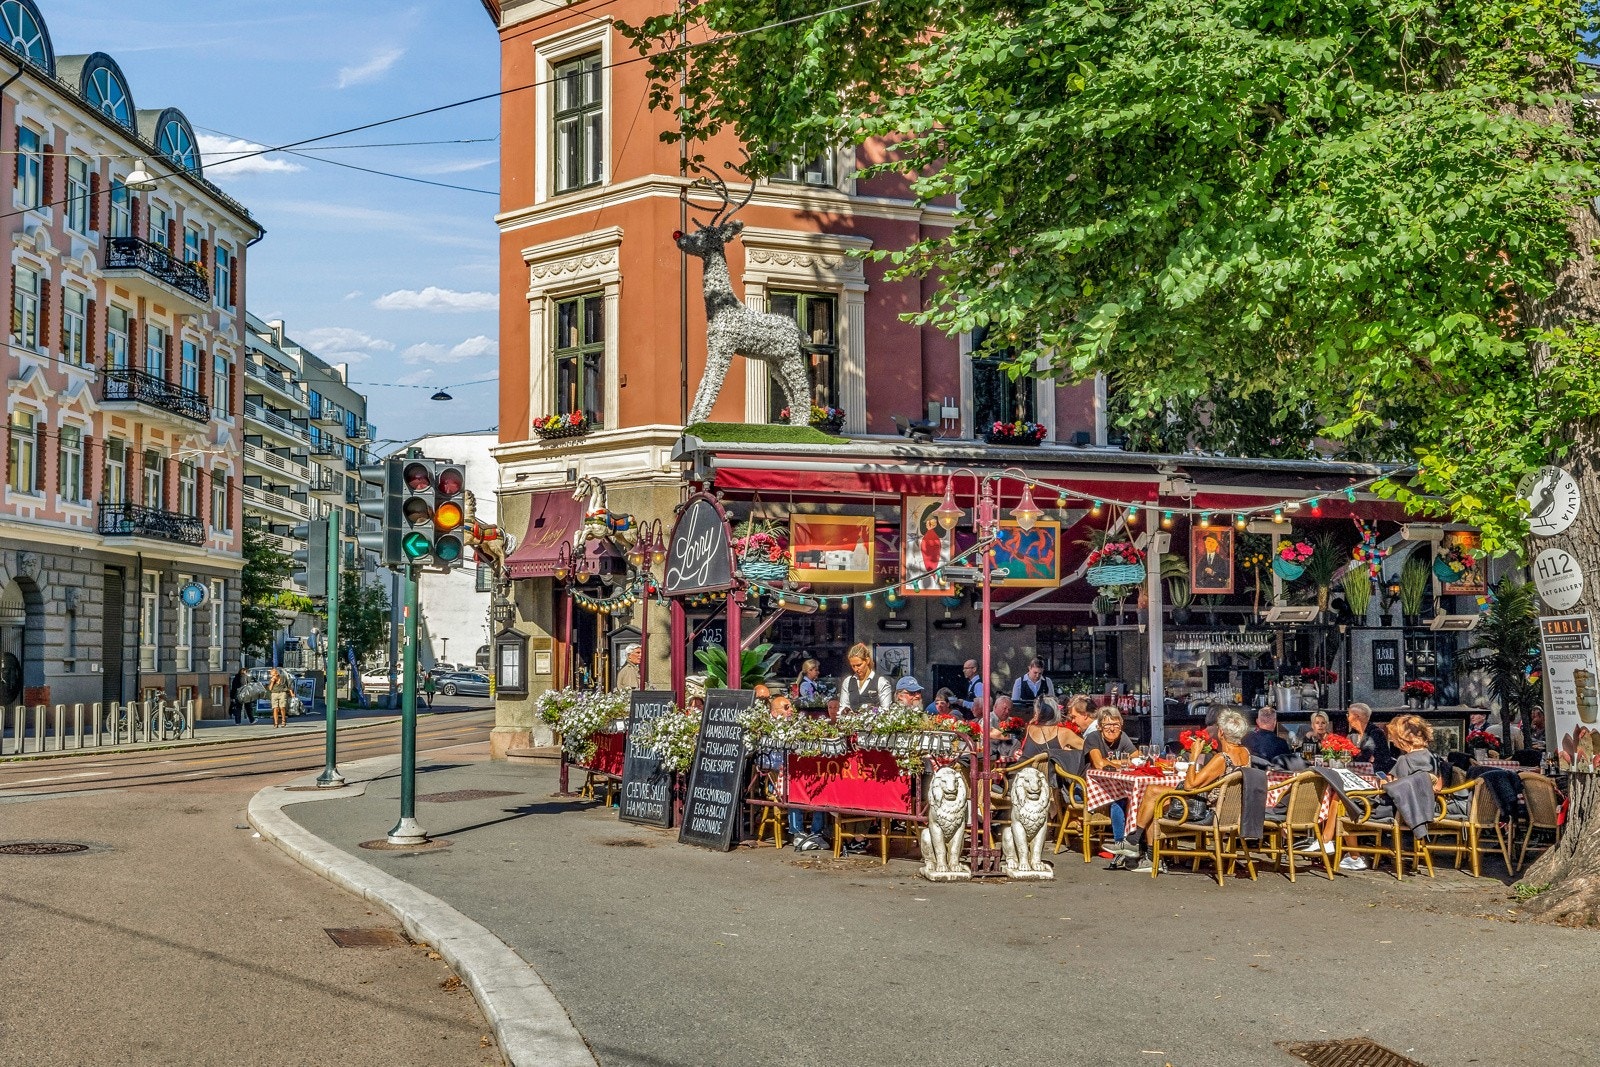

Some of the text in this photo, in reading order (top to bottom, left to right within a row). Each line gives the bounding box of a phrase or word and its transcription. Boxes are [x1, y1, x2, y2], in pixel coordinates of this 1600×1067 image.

[1562, 482, 1577, 521] SYLVIA
[666, 503, 723, 591] Lorry
[1536, 553, 1573, 579] H12
[1542, 582, 1583, 597] ART GALLERY
[702, 628, 723, 643] 225
[1547, 620, 1583, 634] EMBLA
[705, 723, 742, 741] HAMBURGER
[722, 743, 740, 757] CHIPS
[651, 784, 667, 802] SALAT
[693, 802, 706, 815] EGG
[708, 804, 728, 819] BACON
[691, 816, 723, 835] KARBONADE
